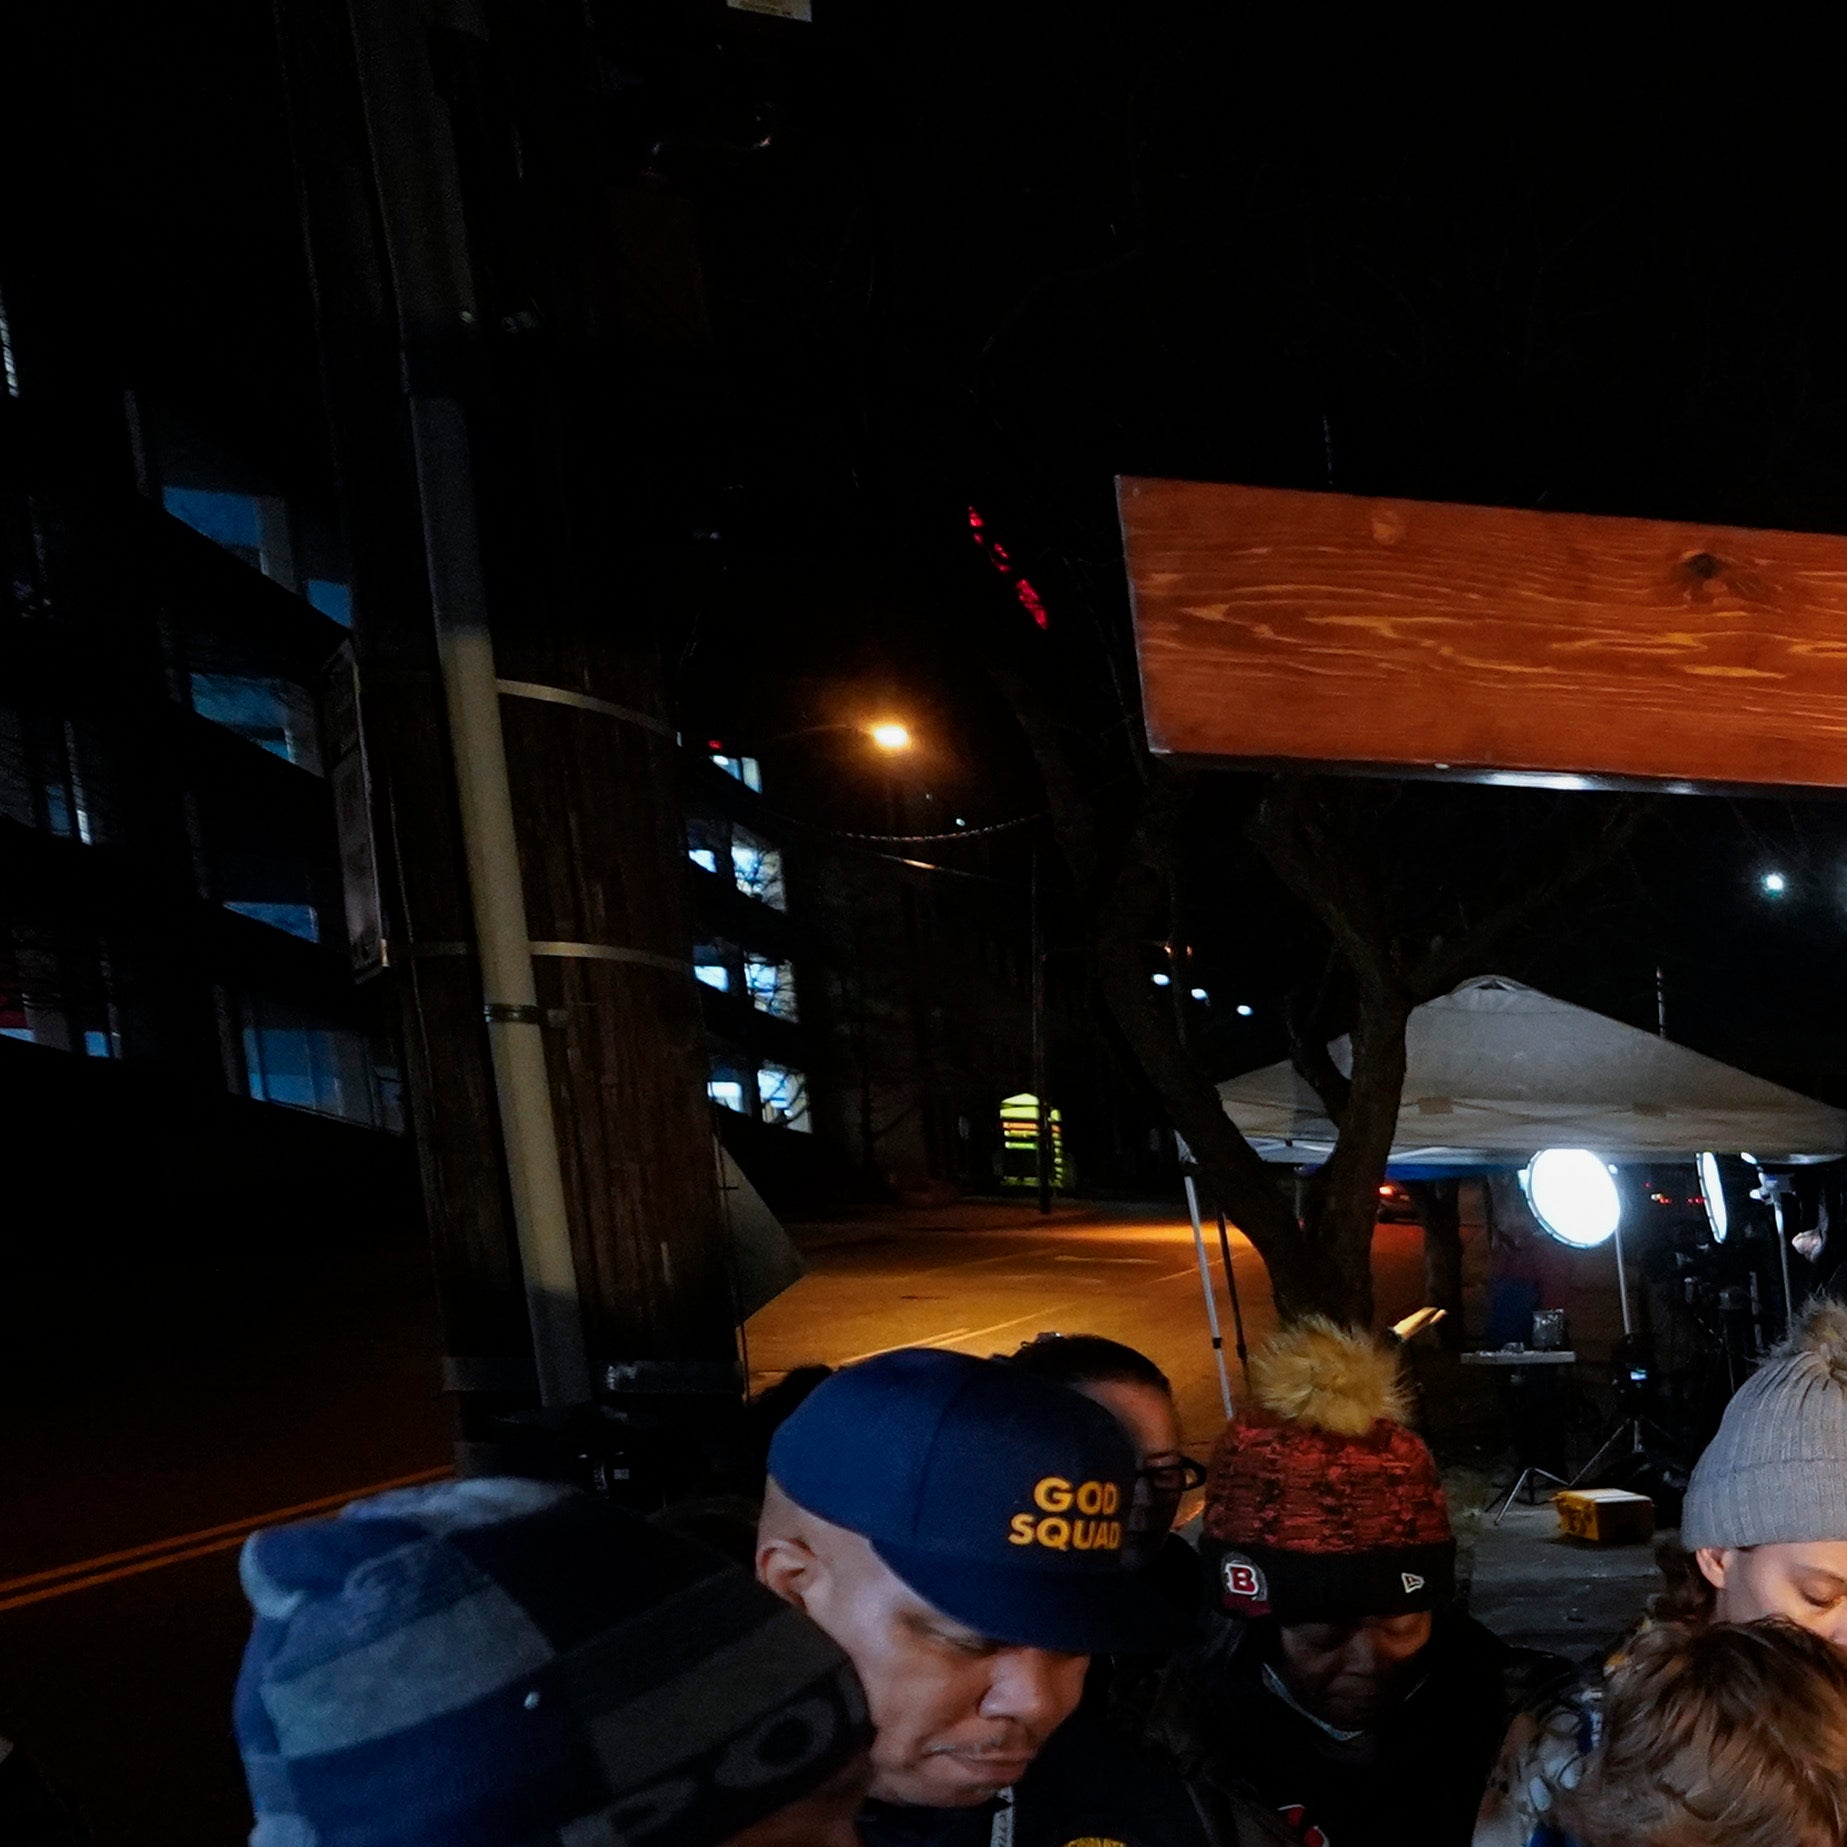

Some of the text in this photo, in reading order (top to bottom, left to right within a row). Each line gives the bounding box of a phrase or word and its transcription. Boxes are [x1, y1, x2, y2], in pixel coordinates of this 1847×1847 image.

[1032, 1475, 1120, 1515] GOD
[1007, 1511, 1121, 1552] SQUAD
[1225, 1562, 1260, 1596] B
